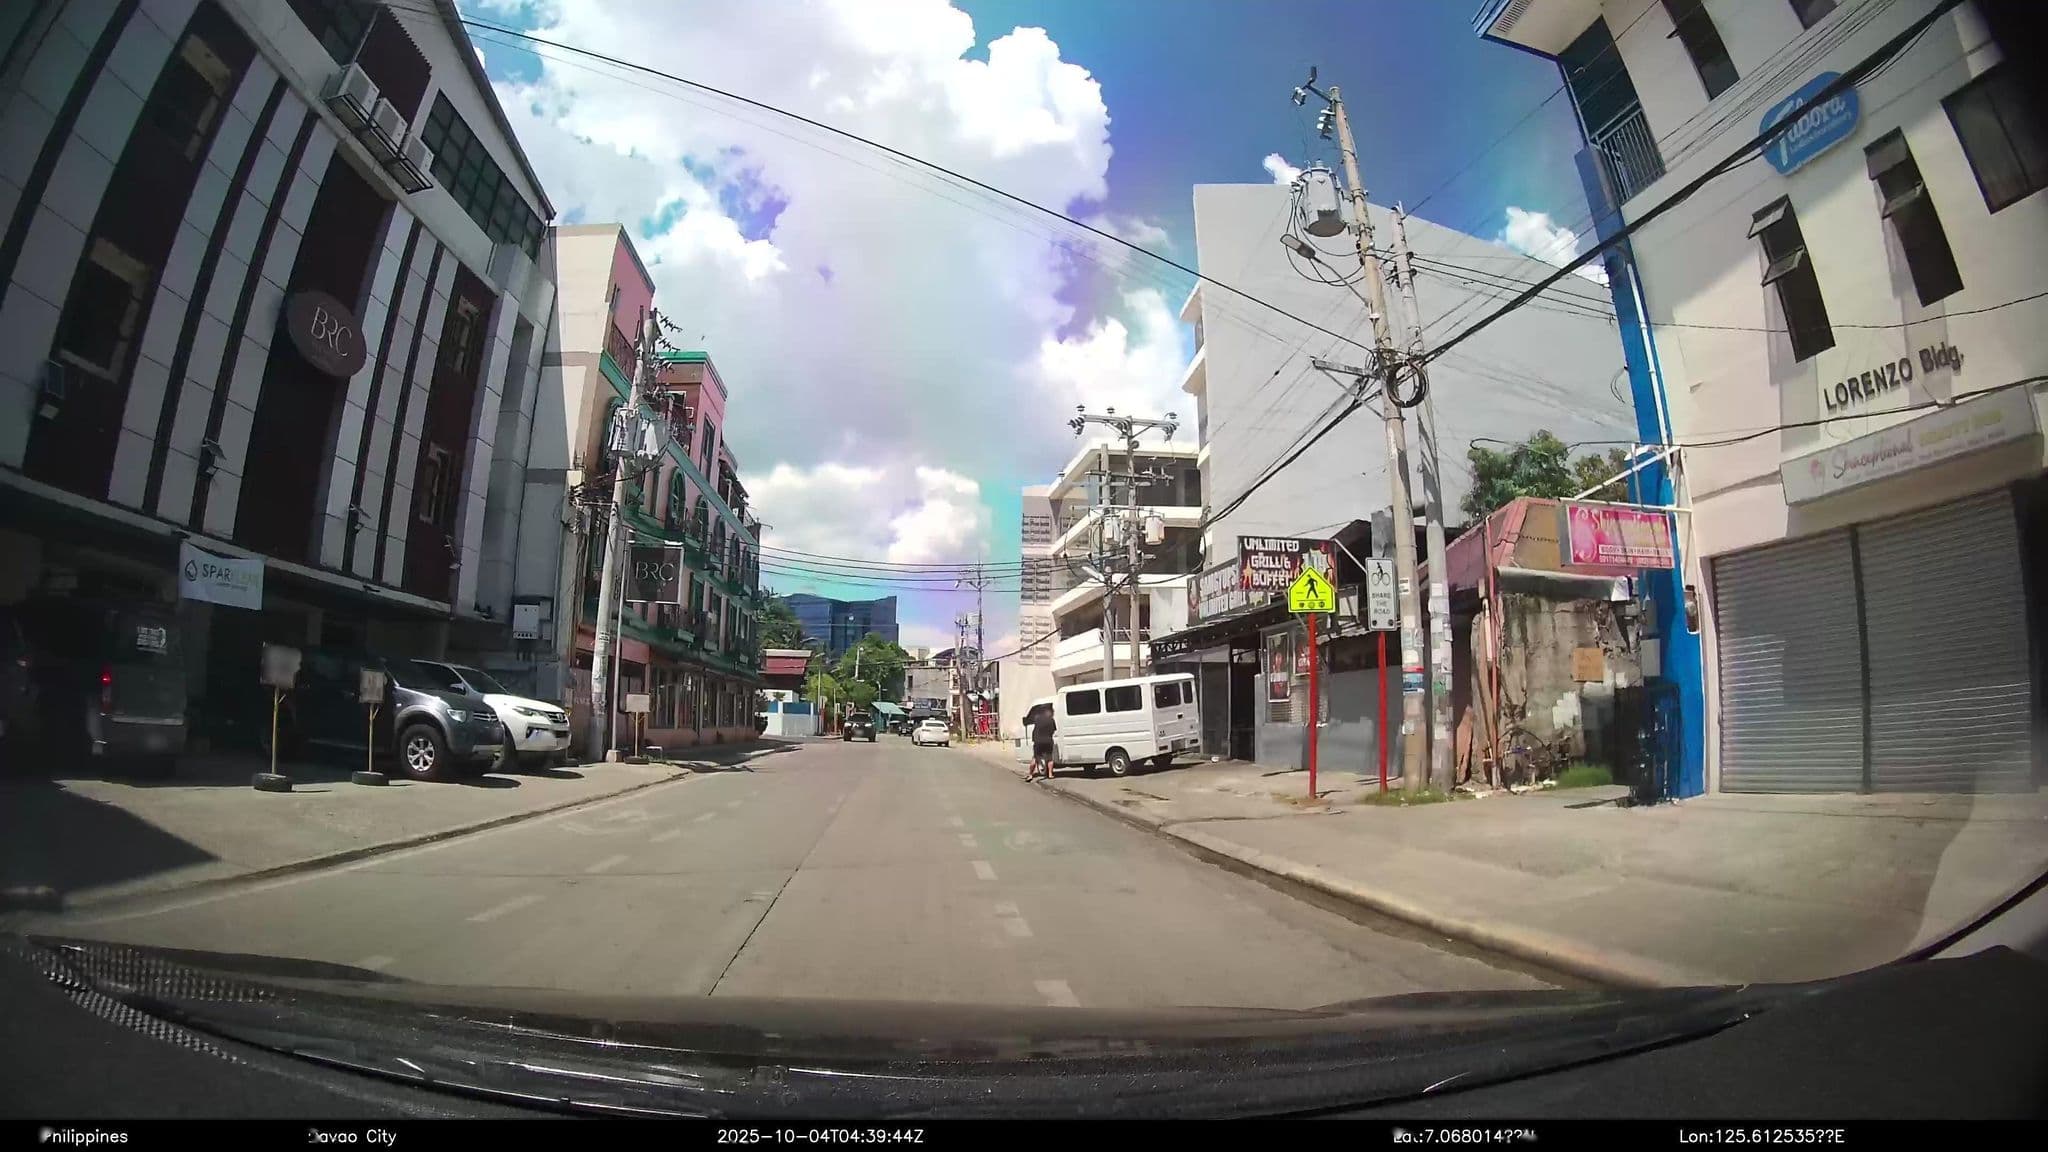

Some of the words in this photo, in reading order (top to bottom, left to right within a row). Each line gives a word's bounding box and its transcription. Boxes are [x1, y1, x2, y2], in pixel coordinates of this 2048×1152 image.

[311, 306, 352, 356] BRC
[1824, 357, 1913, 411] LORENZO
[1919, 341, 1964, 373] Bldg.
[1244, 537, 1299, 552] UNLIMITED
[635, 562, 675, 581] BRC
[1376, 600, 1388, 608] THE
